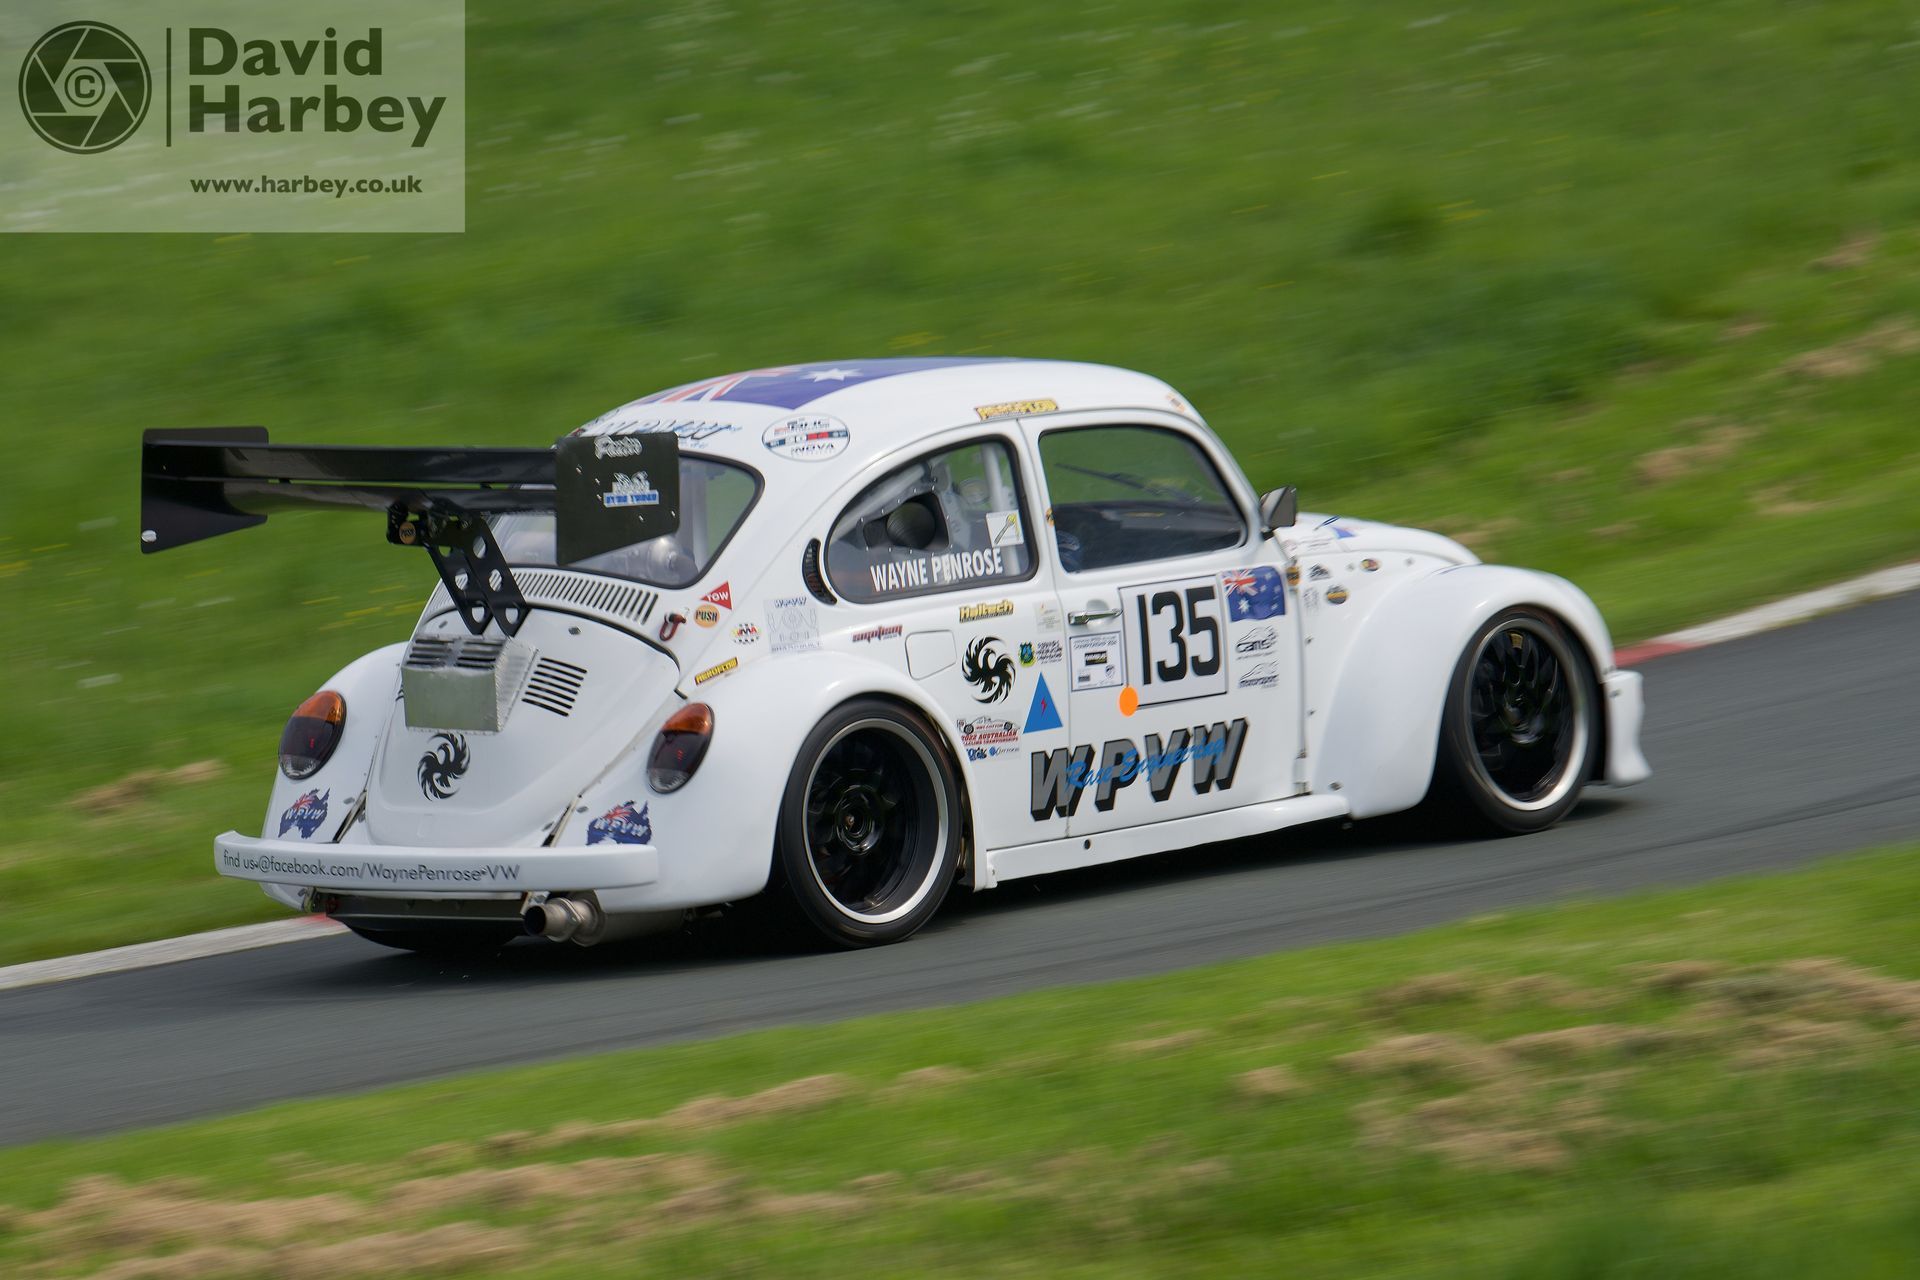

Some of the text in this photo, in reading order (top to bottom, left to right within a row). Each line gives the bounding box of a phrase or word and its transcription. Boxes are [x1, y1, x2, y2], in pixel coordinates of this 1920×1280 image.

[870, 548, 1003, 592] WAYNE PENROSE
[706, 591, 729, 603] TOW
[695, 609, 718, 623] PUSH
[1137, 585, 1221, 685] 135
[1030, 717, 1249, 822] WPVW
[223, 849, 240, 868] find
